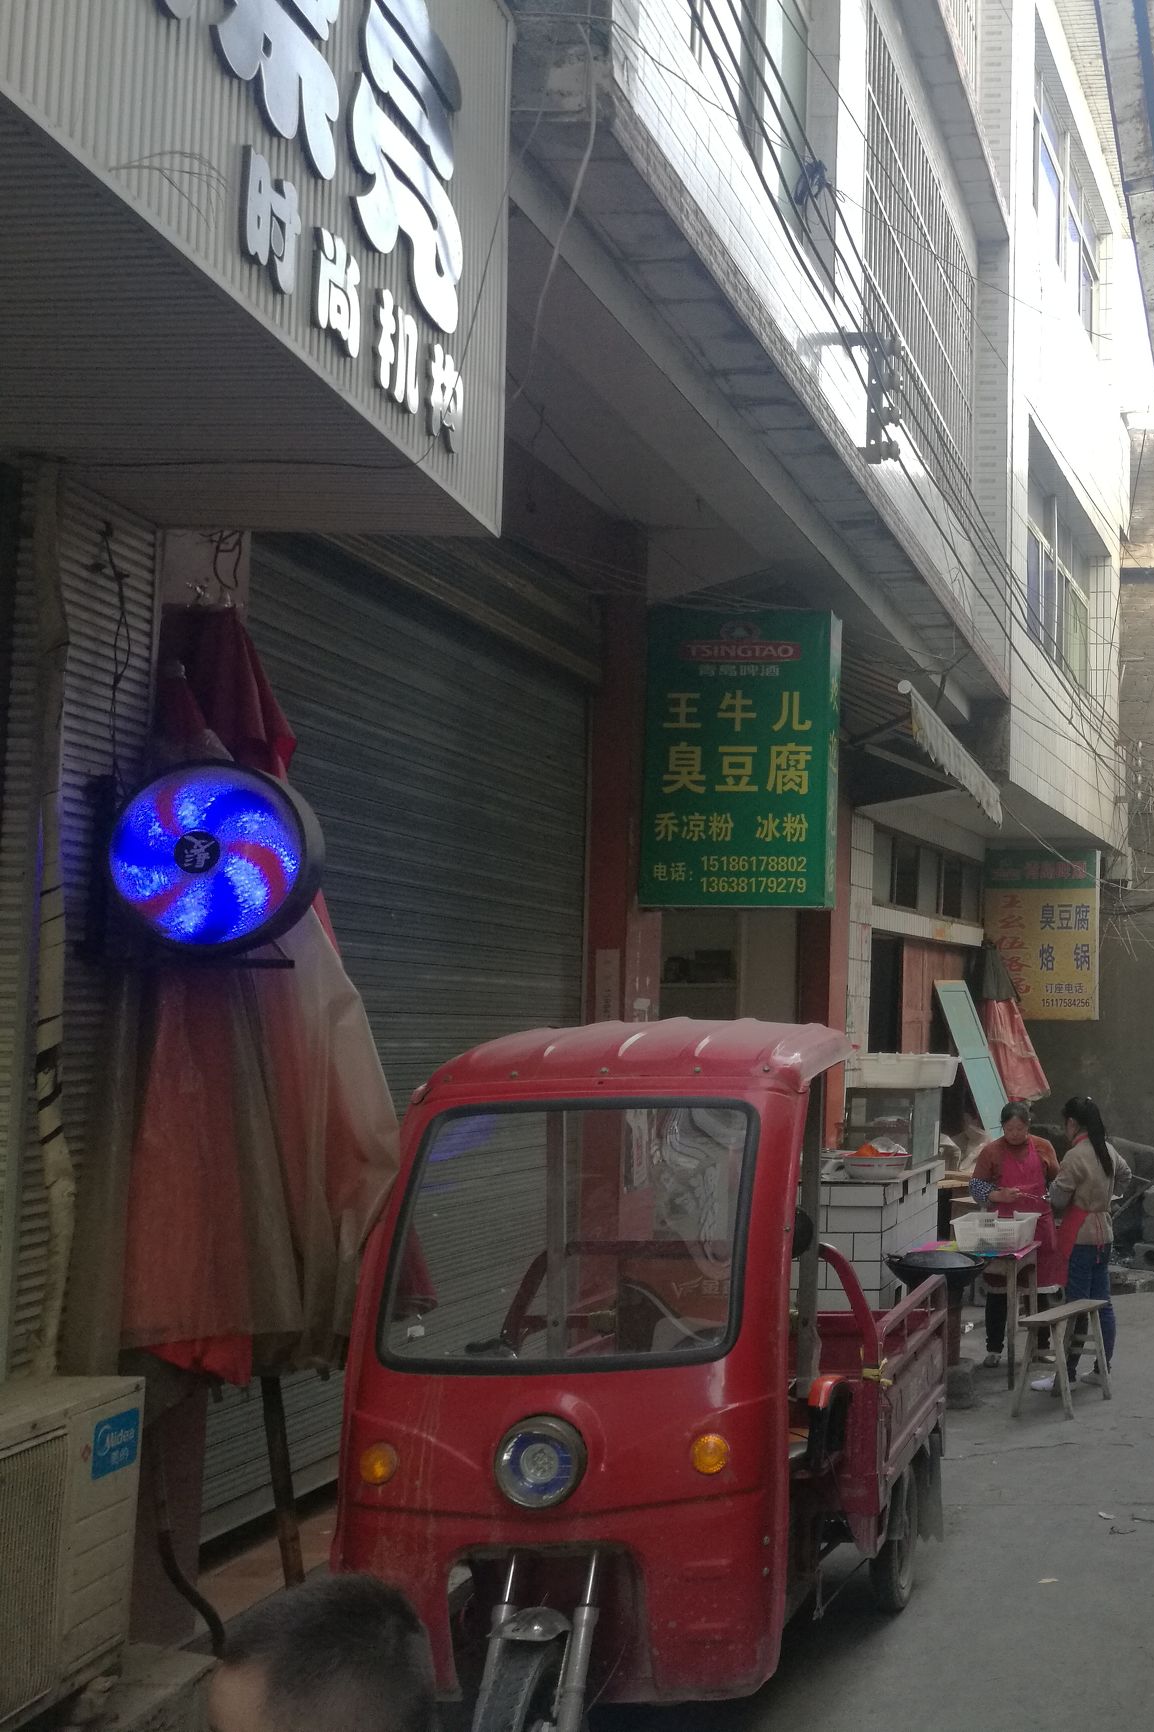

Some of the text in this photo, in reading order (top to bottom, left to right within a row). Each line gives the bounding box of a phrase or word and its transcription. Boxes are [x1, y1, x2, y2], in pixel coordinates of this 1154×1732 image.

[242, 144, 464, 454] 时尚机构
[687, 643, 795, 659] TSINGTAO
[662, 690, 813, 732] 王牛儿
[661, 741, 813, 796] 臭豆腐
[654, 812, 809, 842] 乔凉粉 冰粉
[700, 855, 807, 873] 15186178802
[700, 876, 807, 894] 13638179279
[1039, 903, 1091, 932] 臭豆腐
[105, 1427, 135, 1449] Midea
